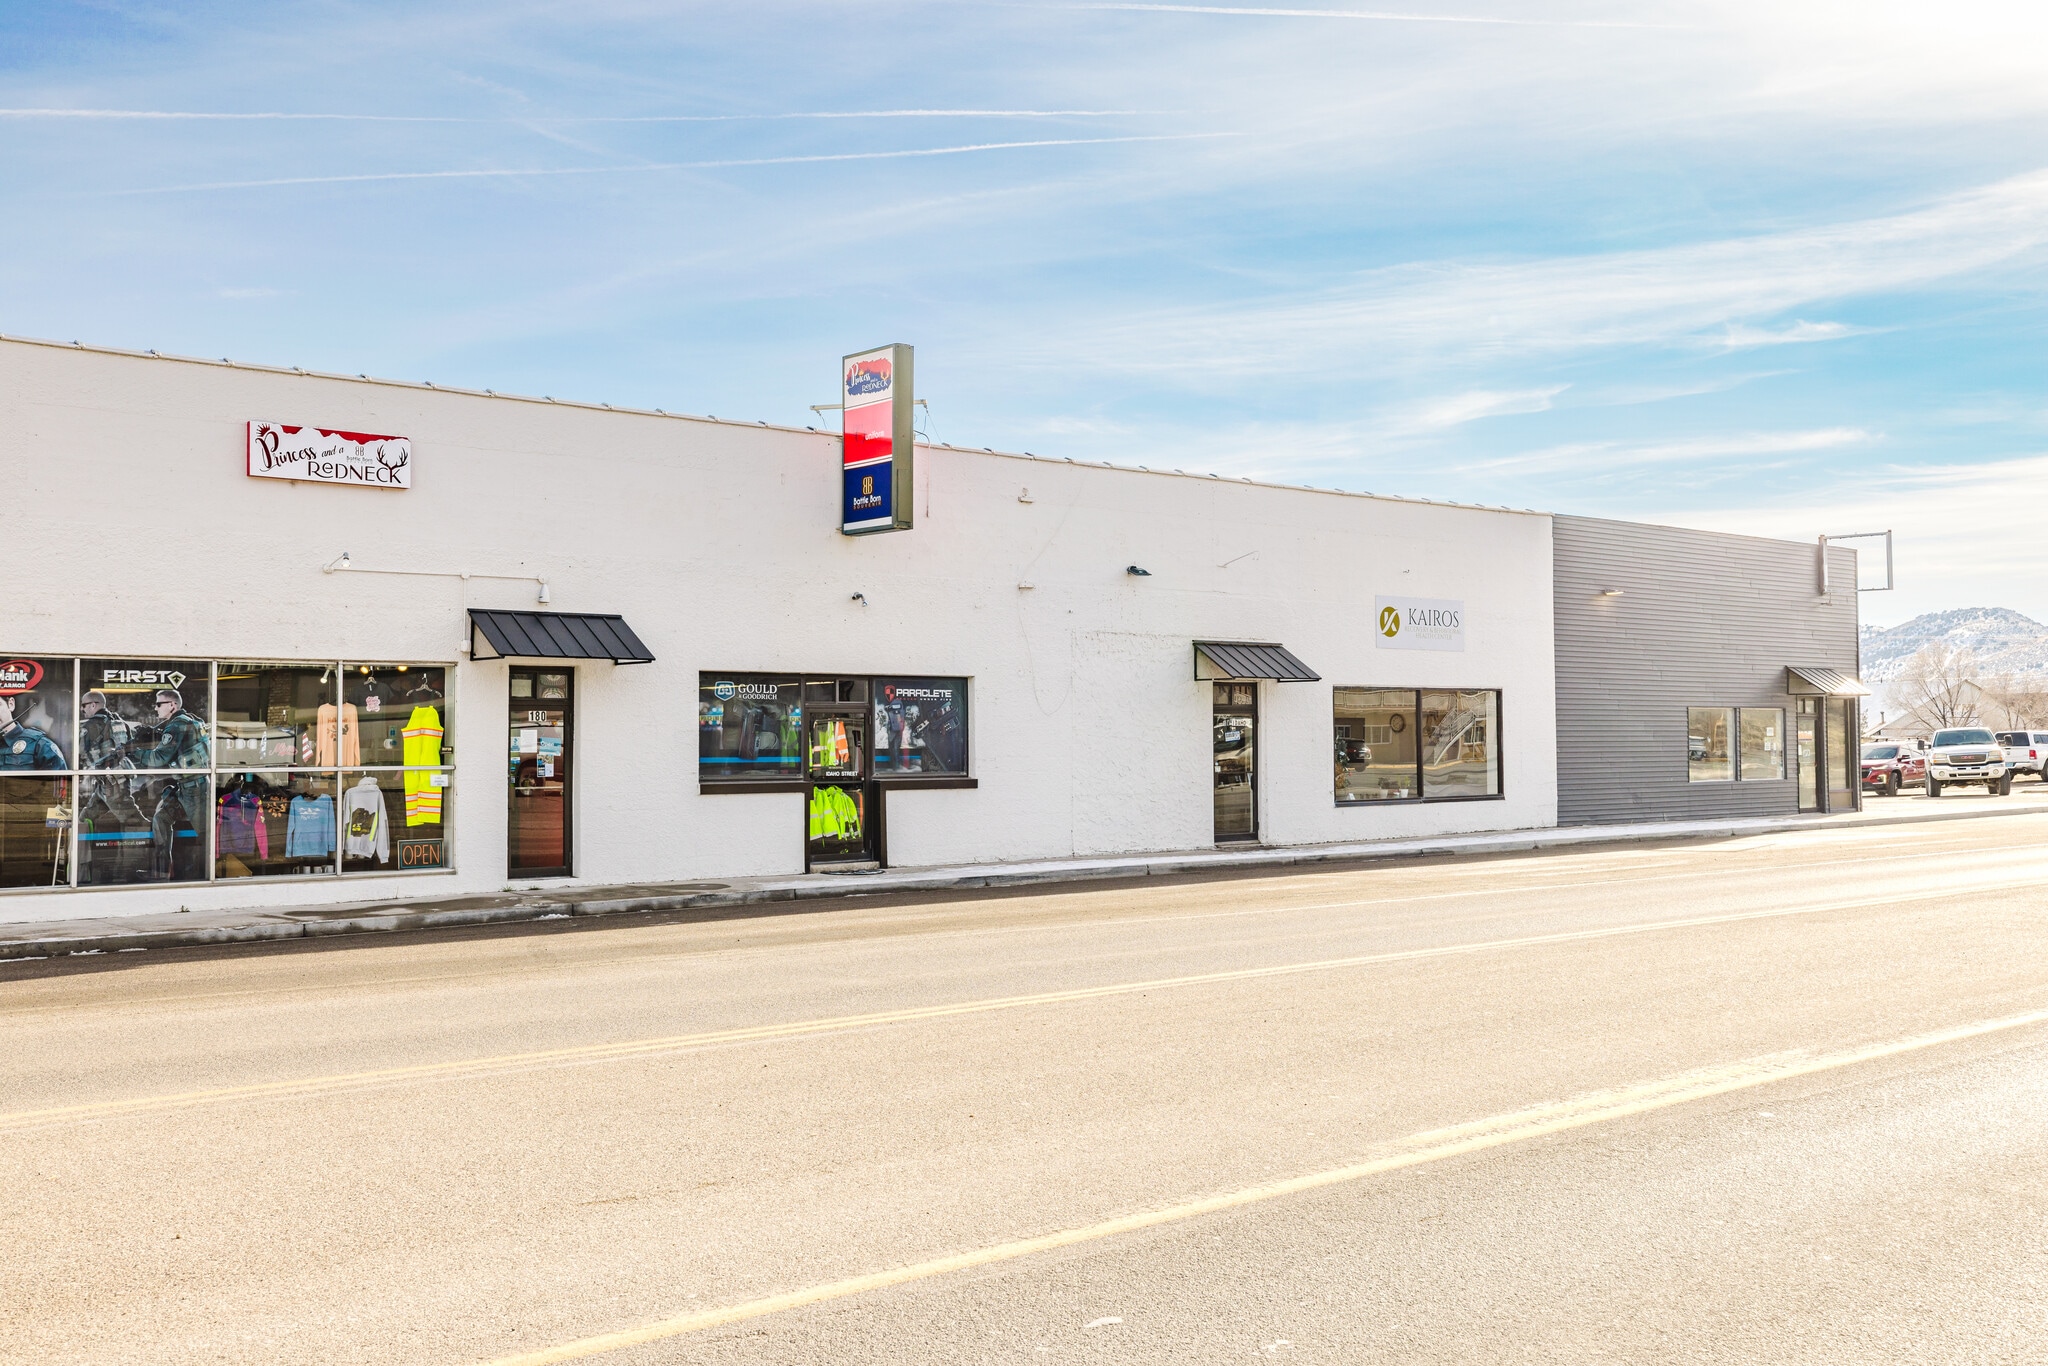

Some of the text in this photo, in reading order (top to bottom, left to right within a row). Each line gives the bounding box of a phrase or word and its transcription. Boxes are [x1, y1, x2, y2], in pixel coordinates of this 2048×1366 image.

[254, 430, 318, 473] Princess
[321, 445, 344, 458] and a
[1408, 607, 1460, 628] KAIROS
[738, 683, 778, 694] GOULD
[896, 688, 953, 698] PARACLETE
[529, 711, 546, 722] 180
[402, 844, 440, 865] OPEN
